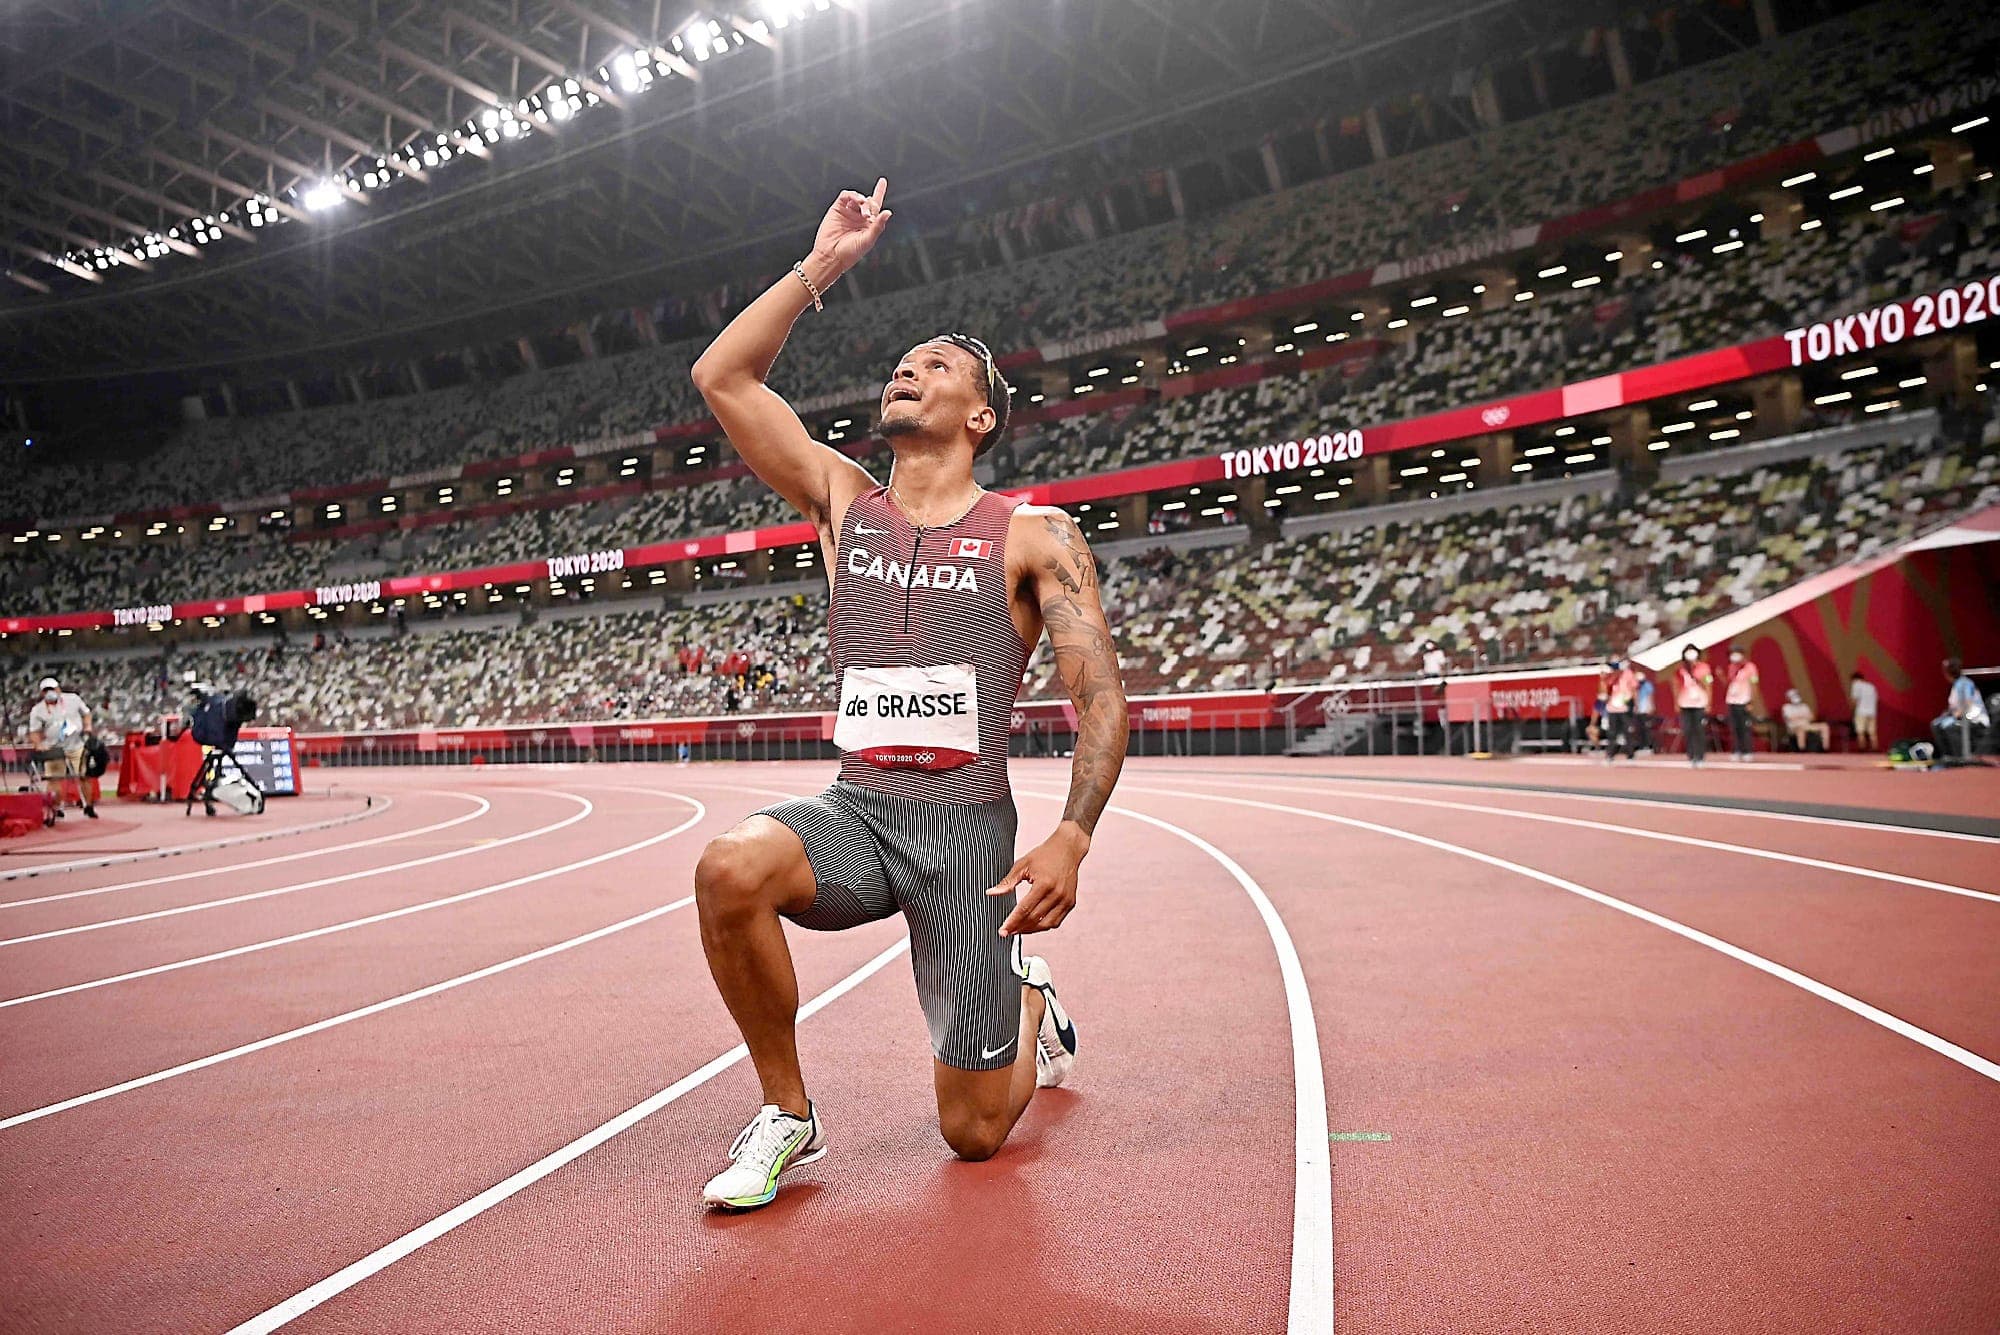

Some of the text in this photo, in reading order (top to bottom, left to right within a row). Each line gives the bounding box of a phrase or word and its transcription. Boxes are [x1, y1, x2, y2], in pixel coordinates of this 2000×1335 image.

[1784, 303, 1905, 367] TOKYO
[1220, 429, 1363, 479] TOKYO 2020
[546, 548, 624, 578] TOKYO 2020
[848, 547, 979, 593] CANADA
[315, 580, 380, 606] TOKYO 2020
[846, 692, 968, 718] de GRASSE
[875, 753, 913, 762] TOKYO 2020
